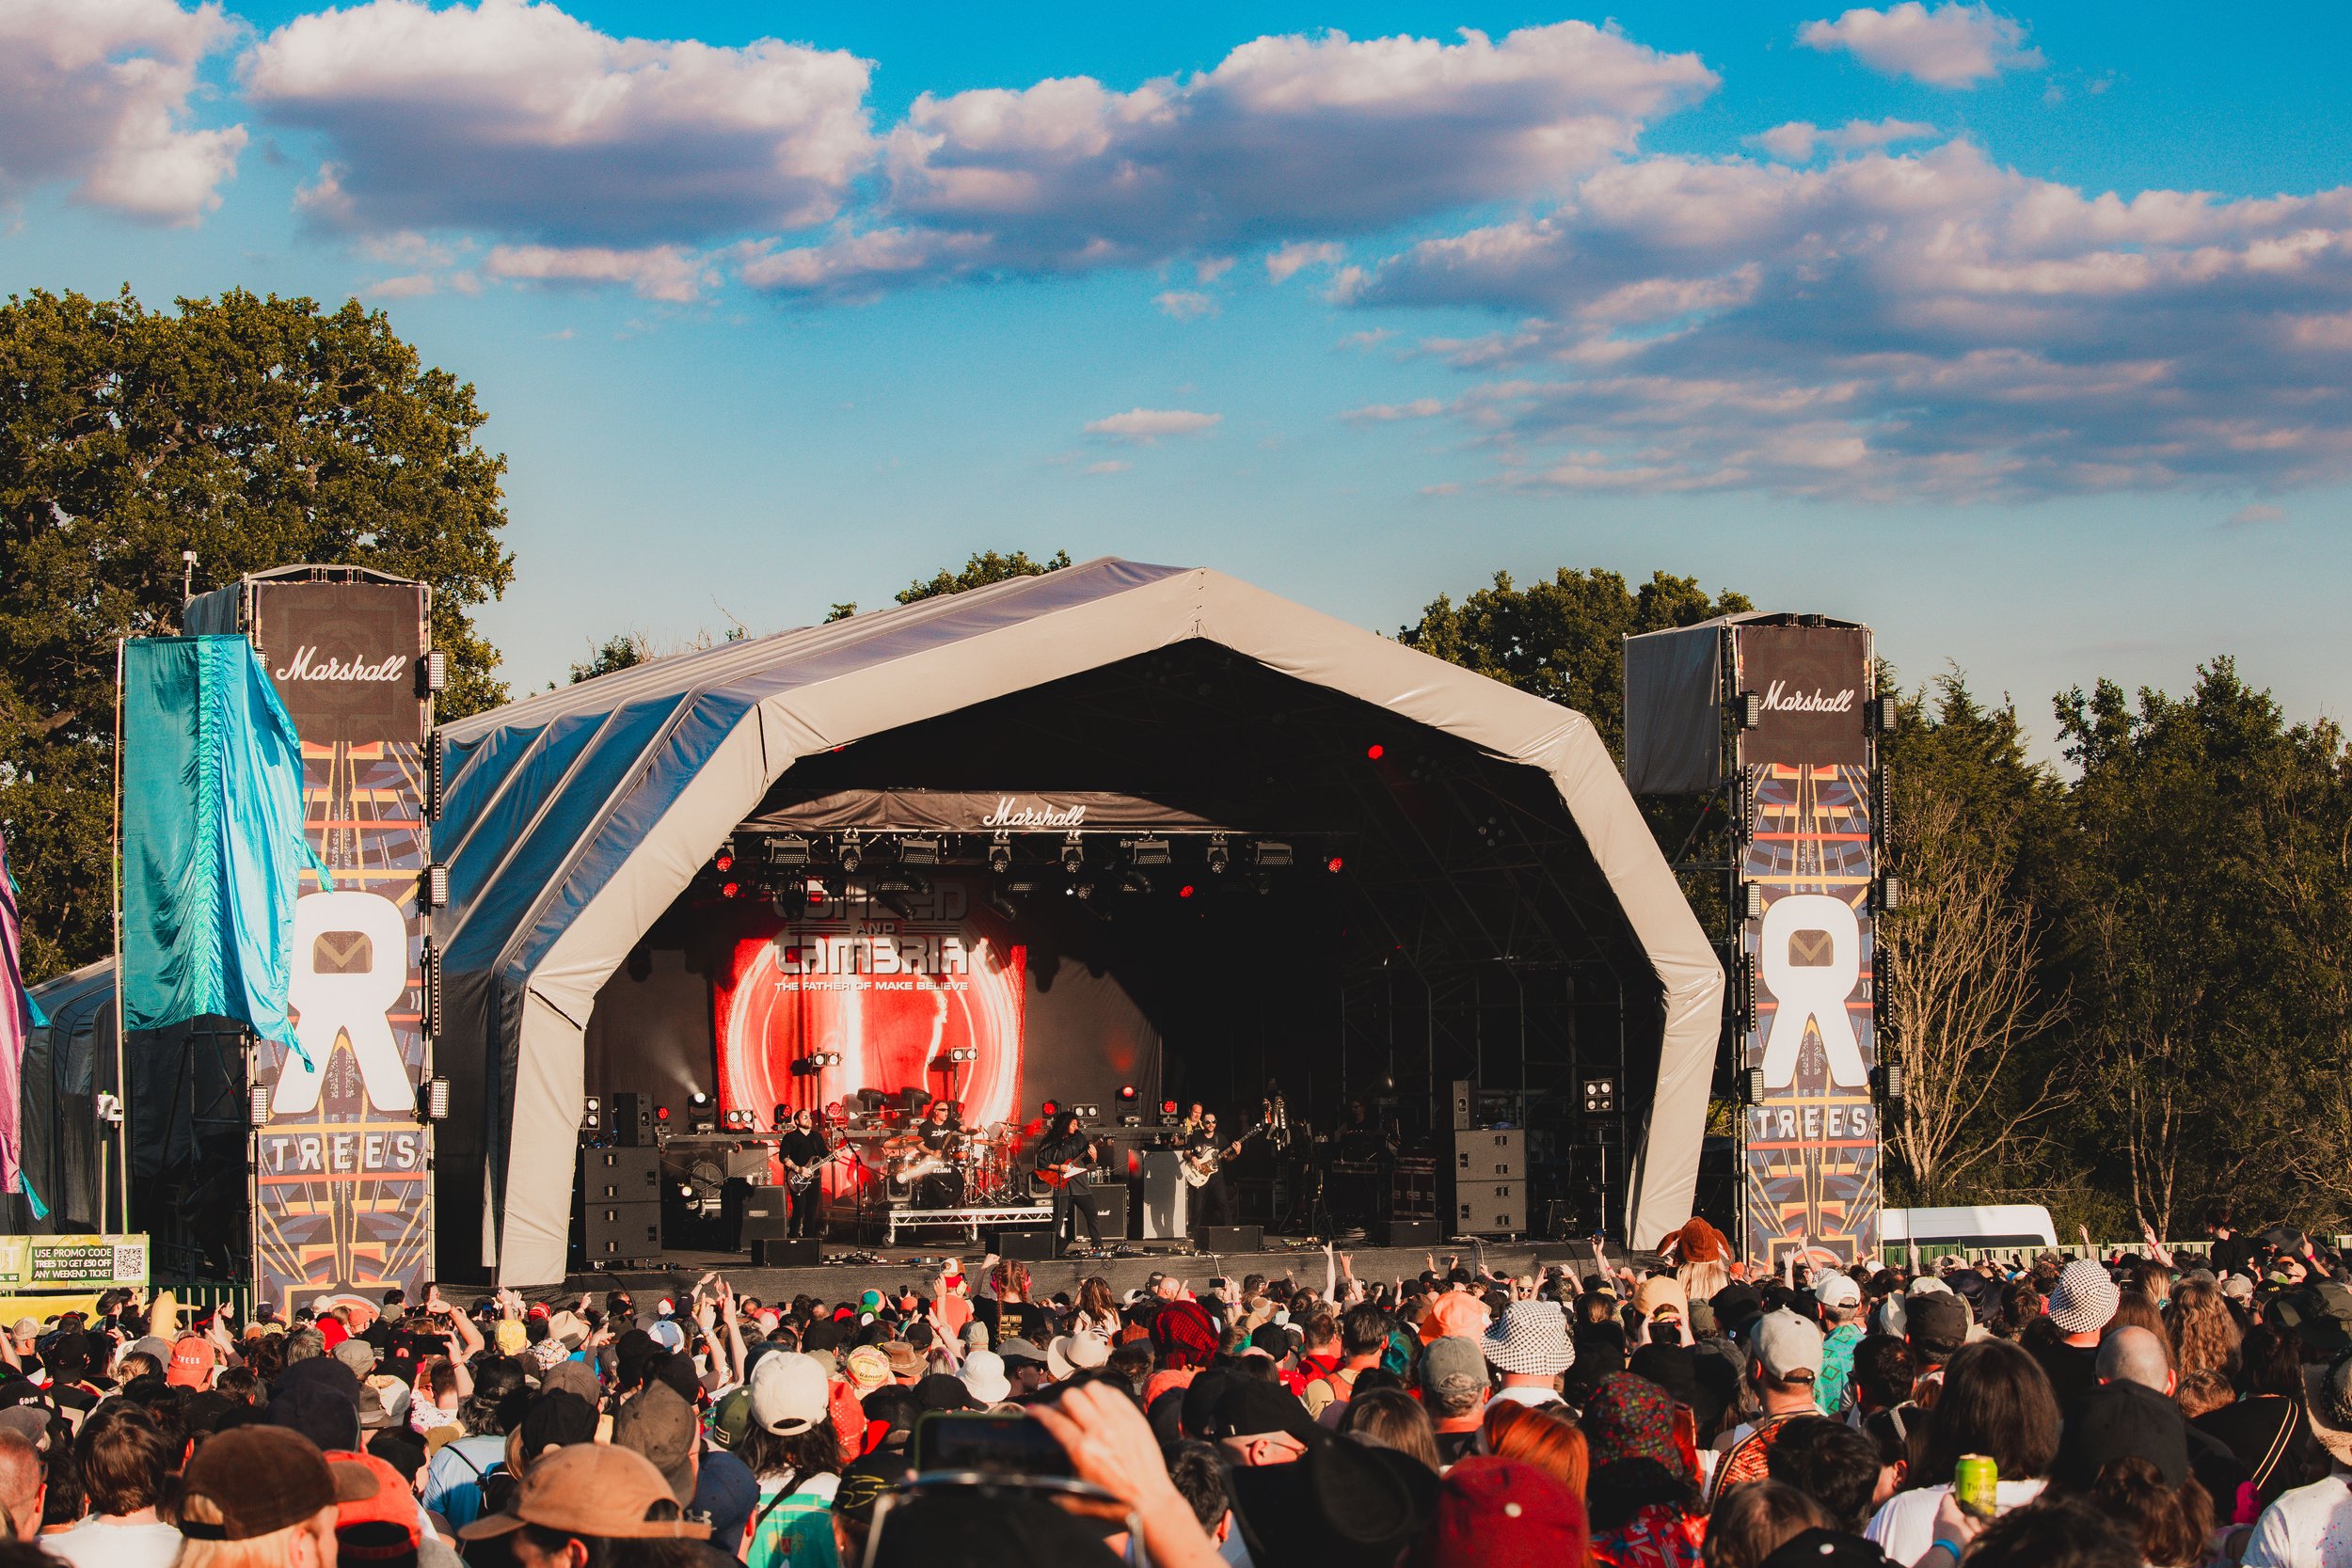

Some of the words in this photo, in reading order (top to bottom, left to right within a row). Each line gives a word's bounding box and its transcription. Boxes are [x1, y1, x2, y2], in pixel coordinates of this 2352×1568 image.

[276, 645, 407, 682] Marshall
[1759, 679, 1855, 713] Marshall
[983, 796, 1087, 828] Marshall
[857, 922, 897, 934] AND
[774, 935, 970, 974] CAMBRIA
[774, 982, 800, 991] THE
[803, 981, 851, 990] FATHER
[855, 981, 872, 990] OF
[875, 981, 914, 990] MAKE
[916, 981, 969, 990] BELIEVE
[1756, 1107, 1867, 1139] TREES
[271, 1135, 417, 1173] TREES
[34, 1248, 51, 1258] USE
[54, 1248, 87, 1258] PROMO
[87, 1248, 112, 1257] CODE
[34, 1270, 51, 1278] ANY
[88, 1269, 112, 1277] TICKET
[177, 1355, 200, 1365] TREES
